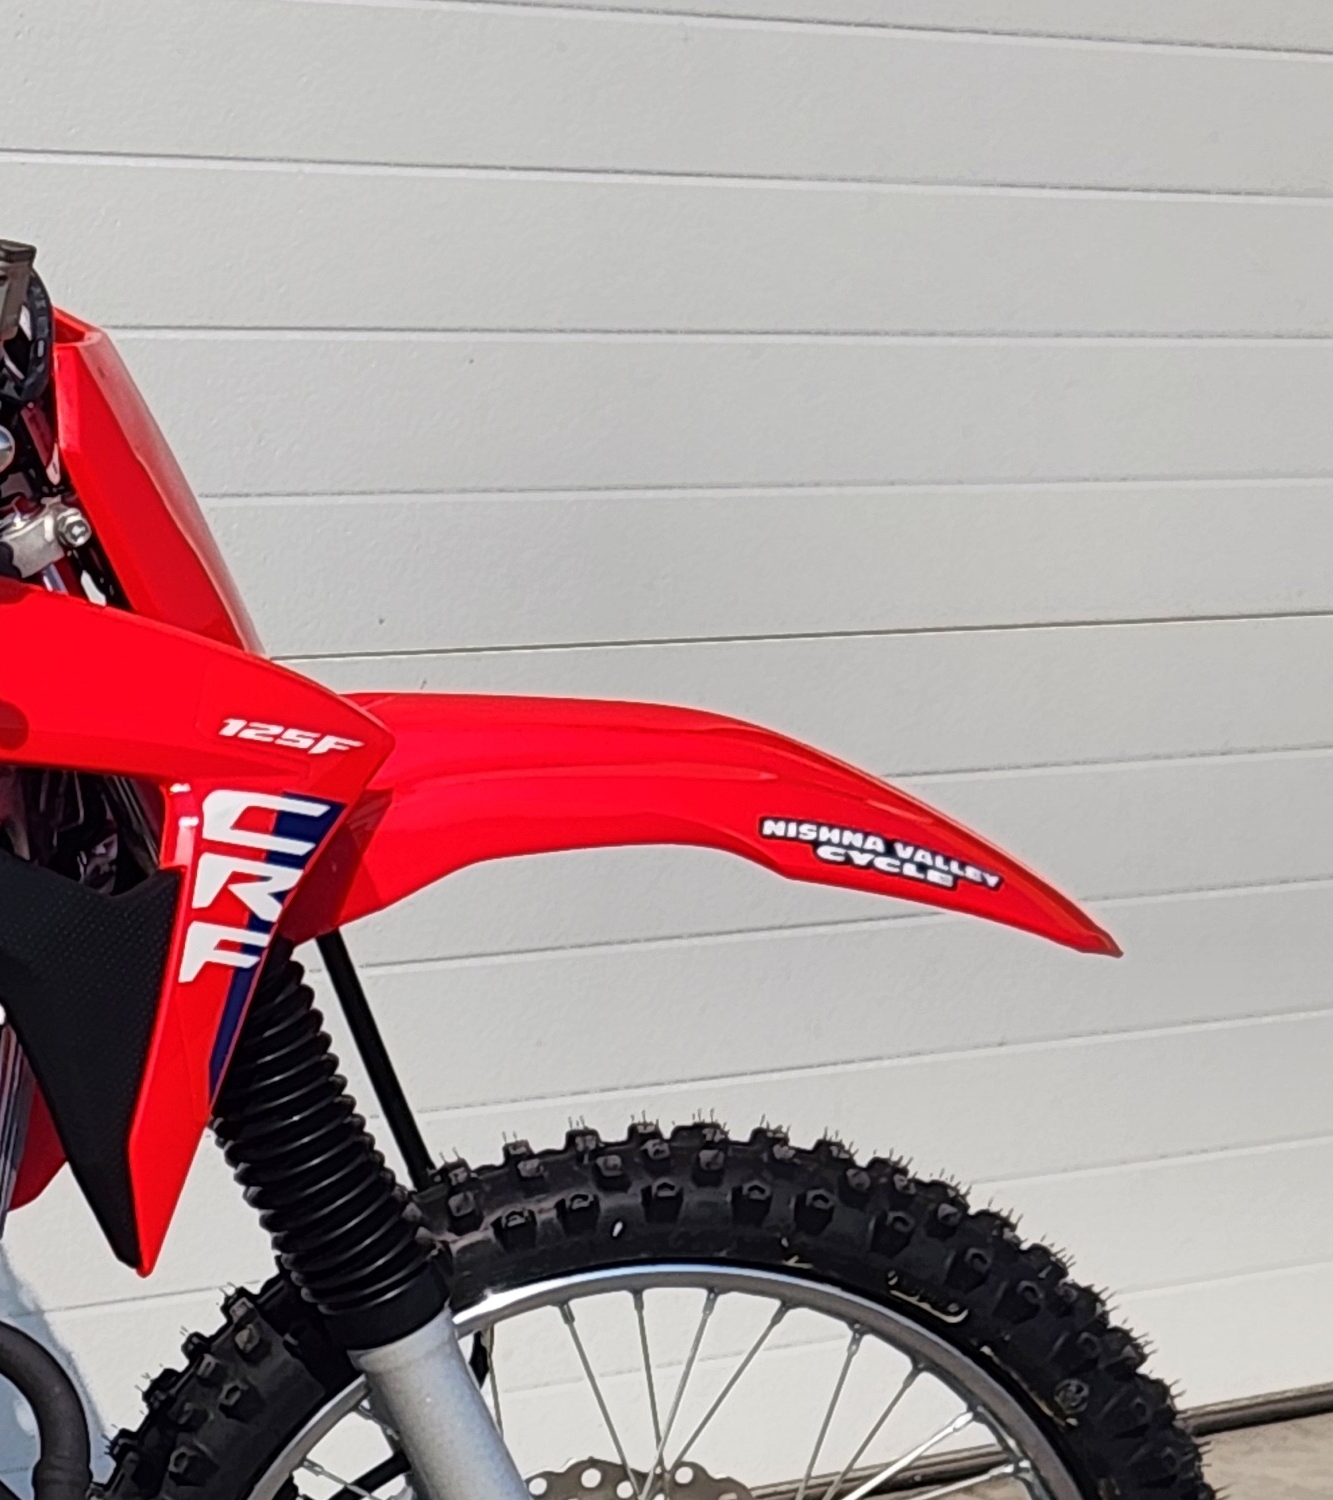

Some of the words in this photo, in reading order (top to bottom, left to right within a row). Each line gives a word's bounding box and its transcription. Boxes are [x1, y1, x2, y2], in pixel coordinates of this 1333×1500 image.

[218, 718, 365, 755] 125F
[762, 819, 886, 853] NISHNA
[894, 842, 1001, 887] VALLEY
[816, 845, 954, 887] CYCLE
[178, 789, 331, 983] CRF
